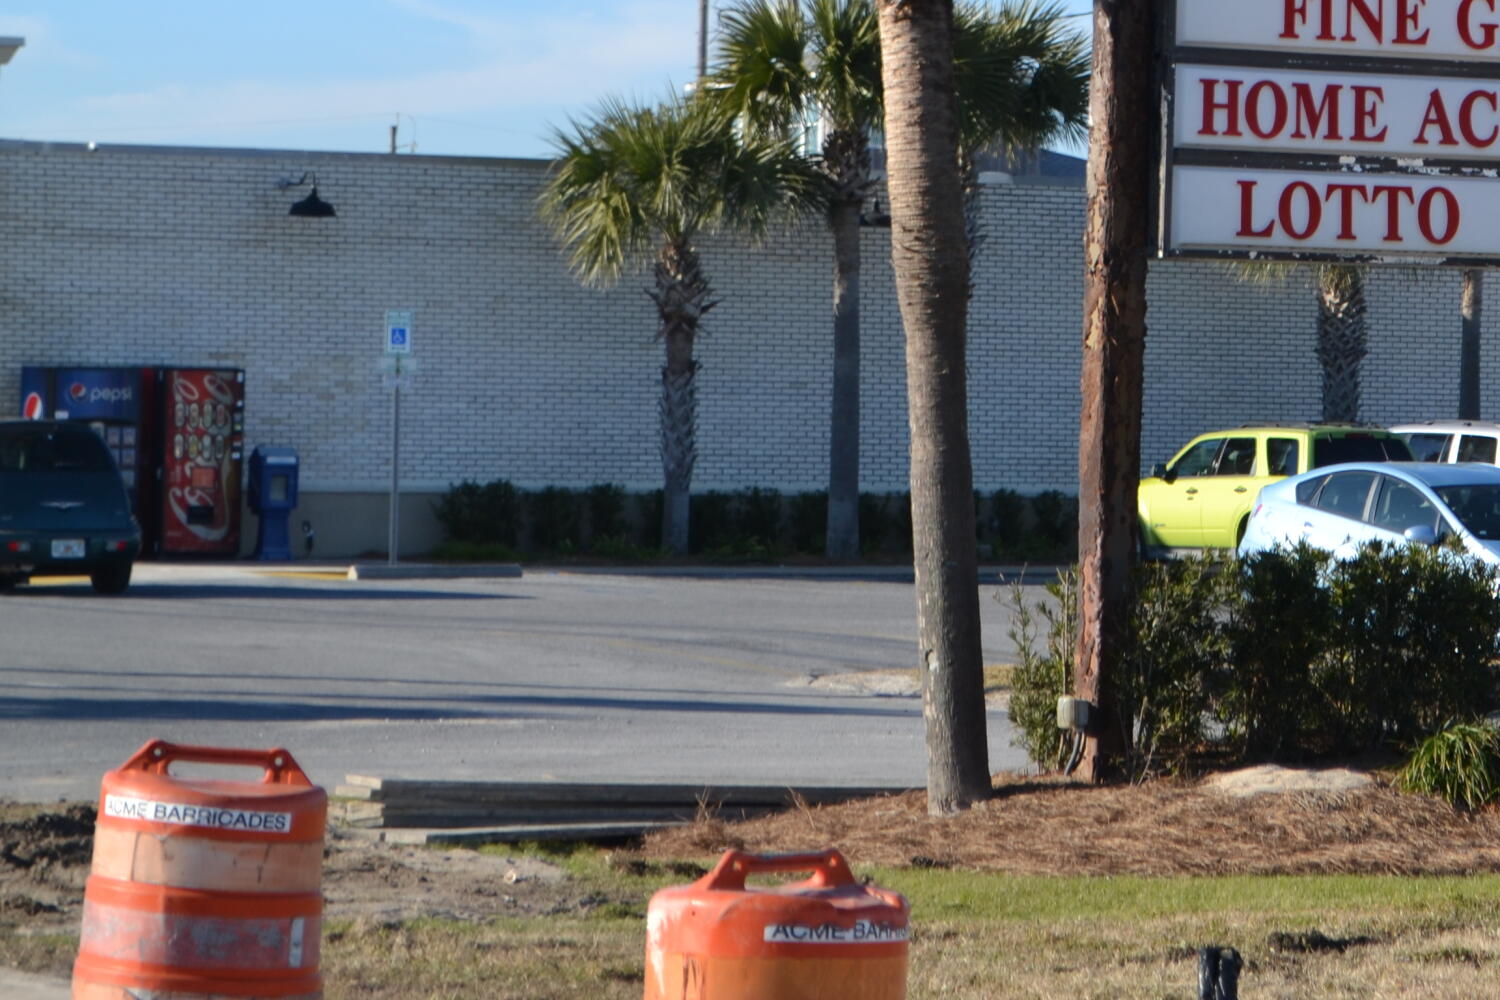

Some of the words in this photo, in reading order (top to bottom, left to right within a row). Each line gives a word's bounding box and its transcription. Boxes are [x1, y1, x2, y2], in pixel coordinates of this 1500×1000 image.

[1197, 79, 1389, 143] HOME
[1235, 180, 1461, 245] LOTTO
[90, 386, 132, 403] pepsi
[153, 803, 287, 830] BARRICADES
[772, 923, 846, 940] ACME
